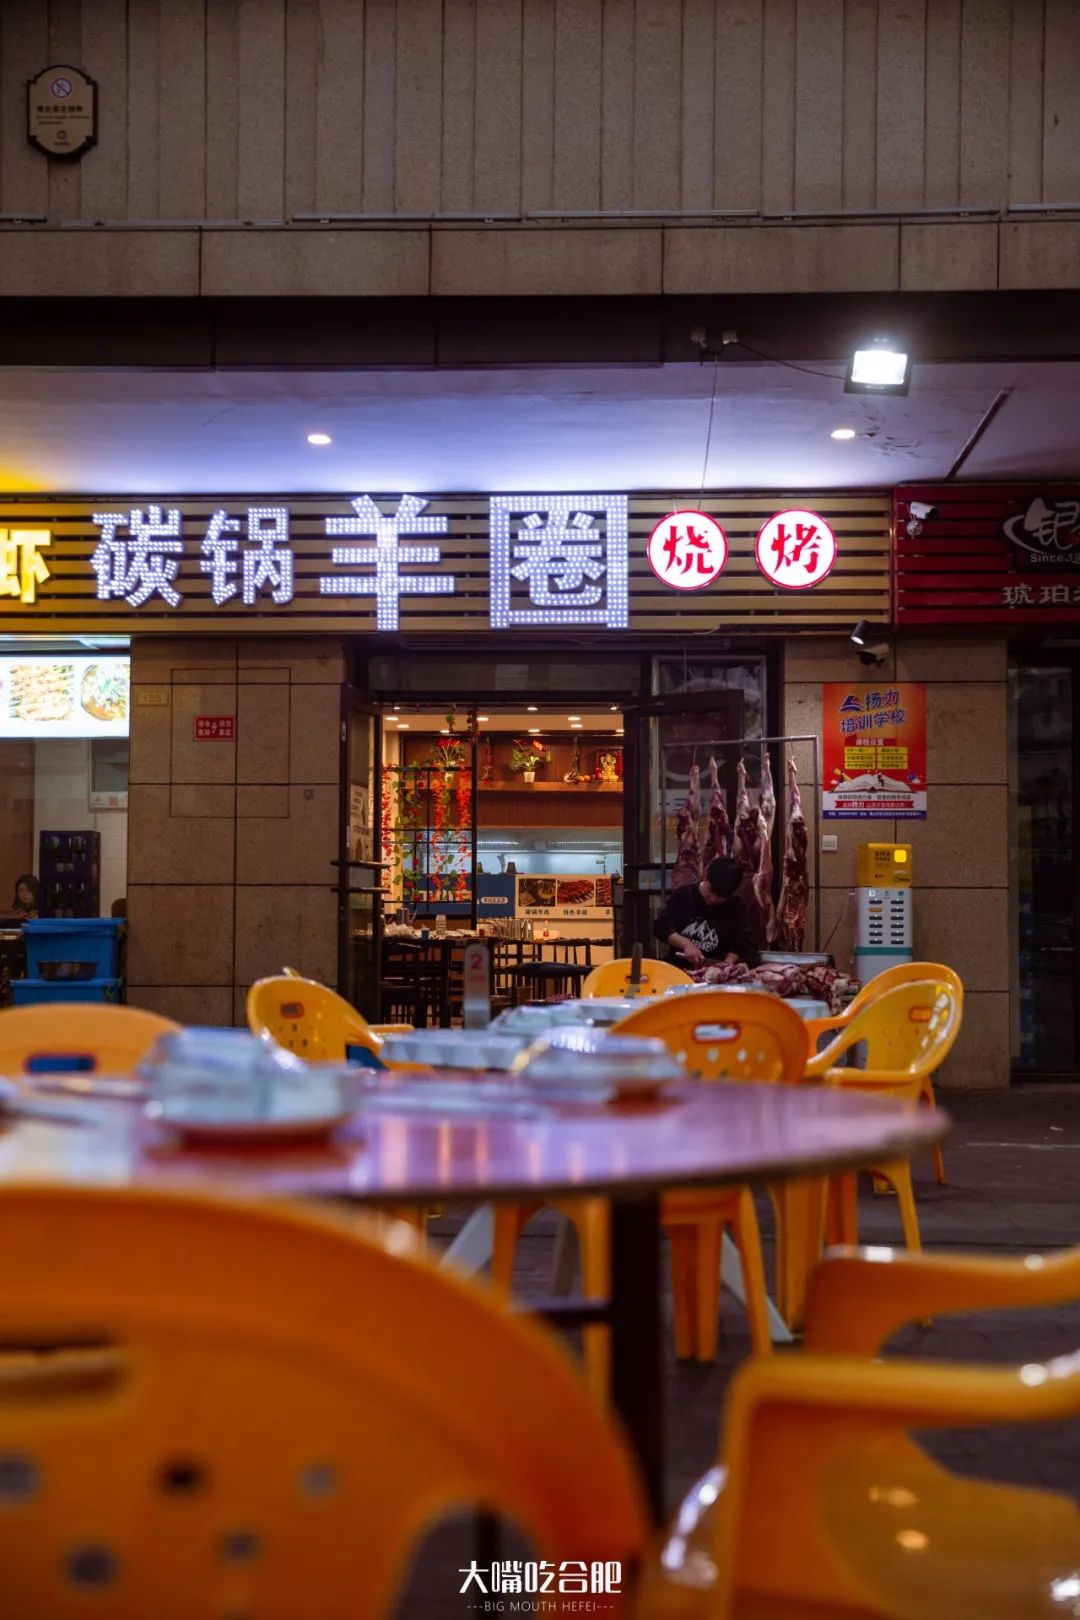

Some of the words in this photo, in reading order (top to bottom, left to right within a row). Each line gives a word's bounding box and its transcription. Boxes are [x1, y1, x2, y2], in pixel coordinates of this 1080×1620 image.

[0, 527, 51, 603] 虾
[90, 493, 629, 632] 碳锅羊圈
[663, 522, 822, 575] 烧烤
[864, 689, 900, 709] 扬力
[841, 709, 906, 733] 培训学校
[470, 953, 482, 970] 2
